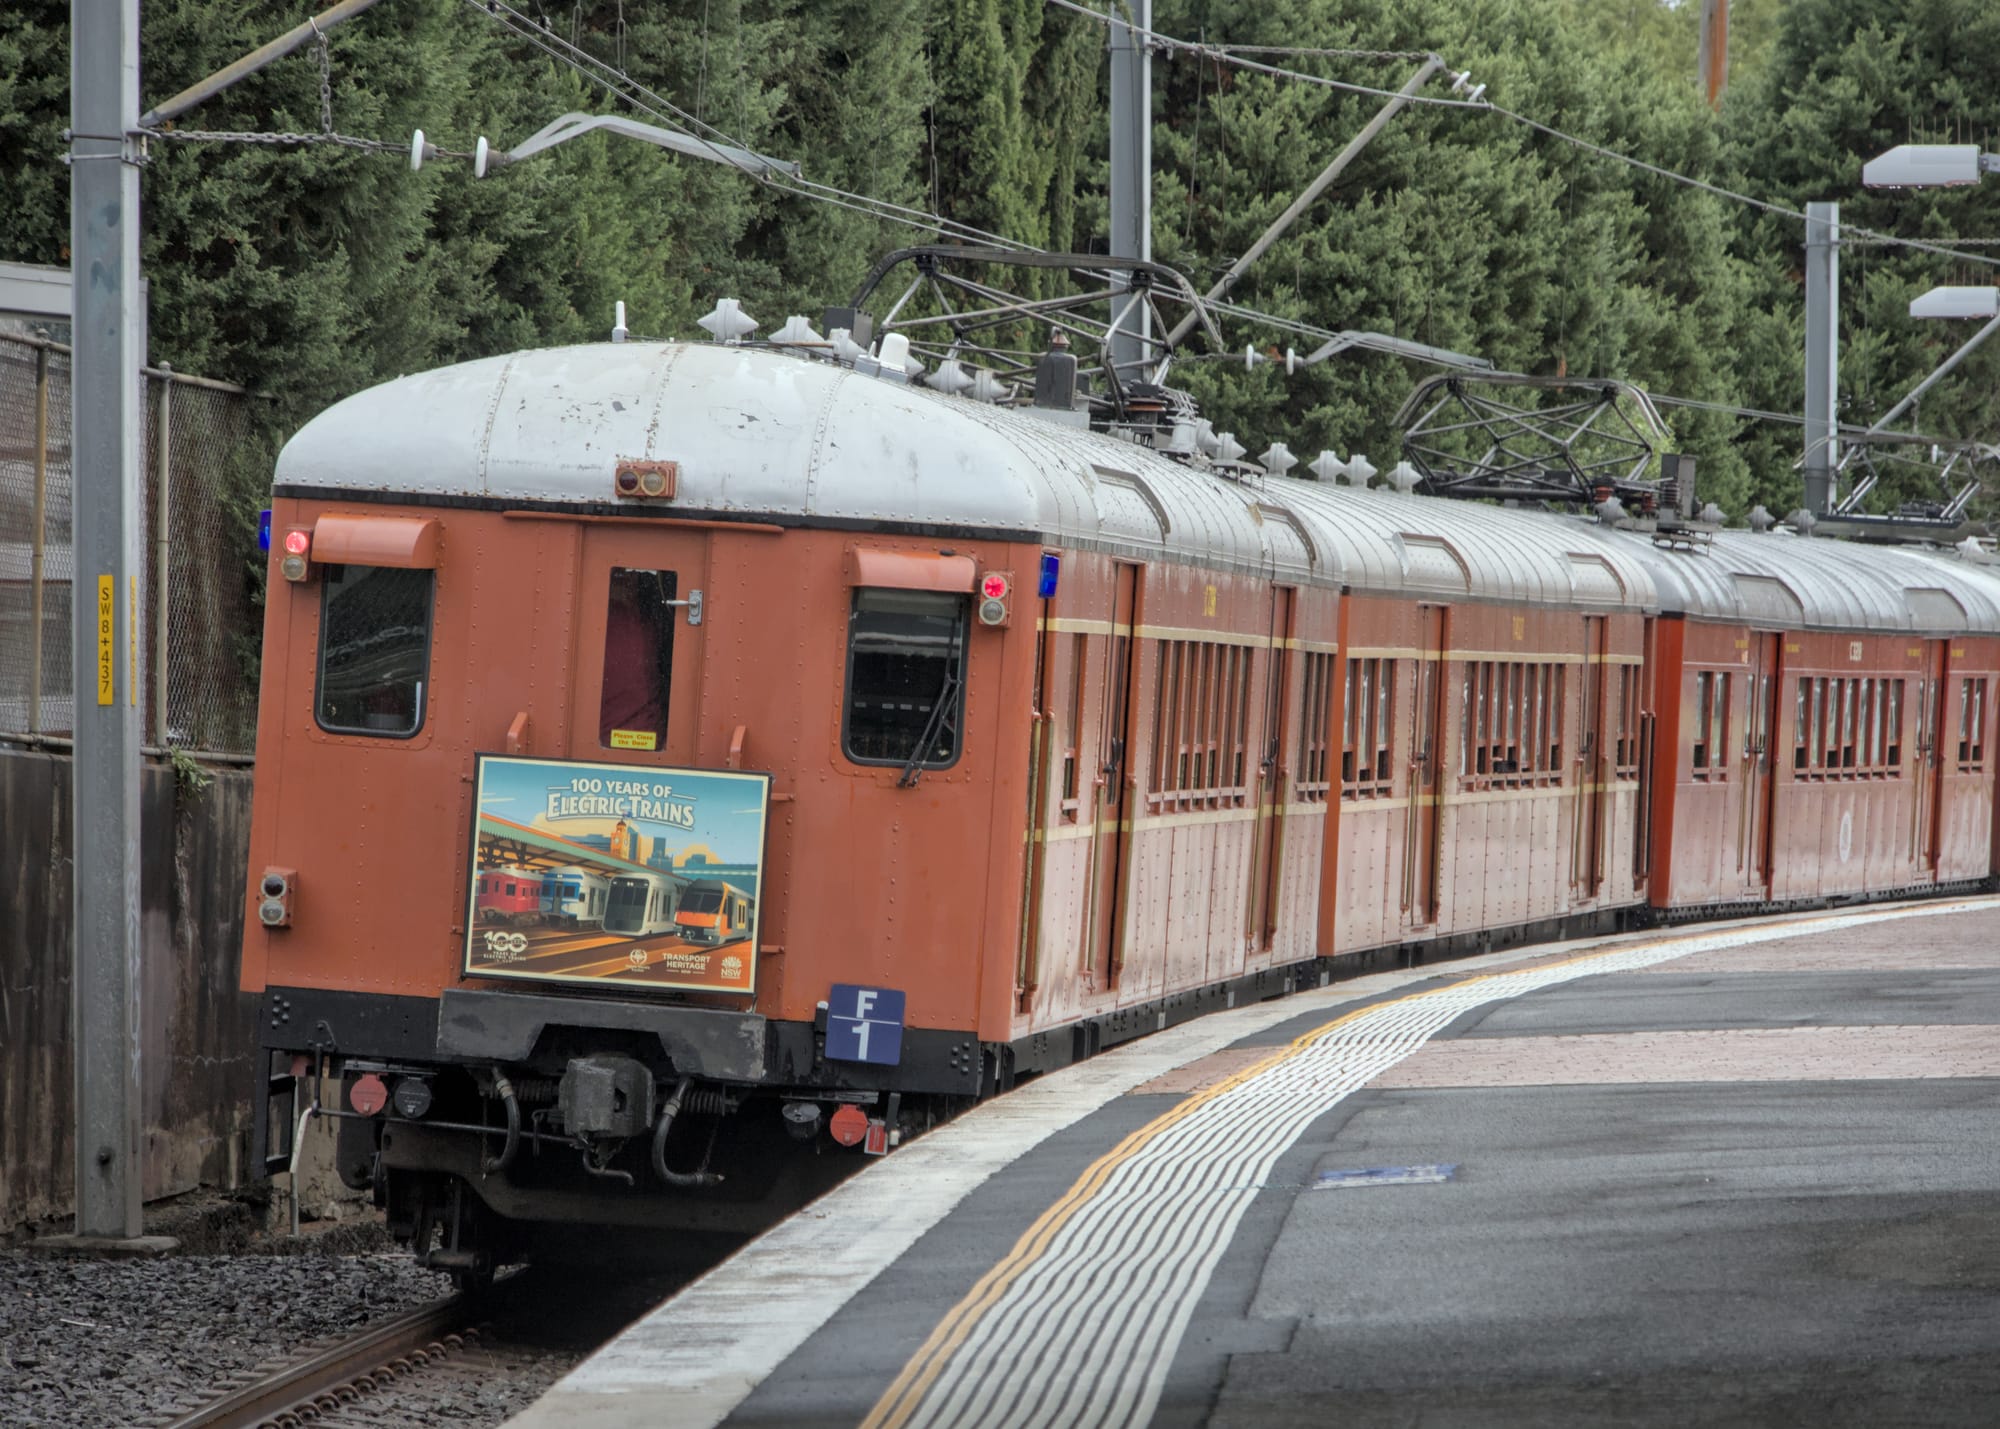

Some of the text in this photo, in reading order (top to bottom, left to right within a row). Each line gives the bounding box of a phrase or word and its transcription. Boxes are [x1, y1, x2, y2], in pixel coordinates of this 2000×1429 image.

[571, 778, 673, 798] 100 YEARS OF
[547, 793, 694, 827] ELECTRIC TRAINS
[662, 952, 712, 963] TRANSPORT
[666, 960, 706, 970] HERITAGE
[720, 968, 742, 977] NSW
[856, 990, 878, 1019] F
[852, 1021, 870, 1060] 1
